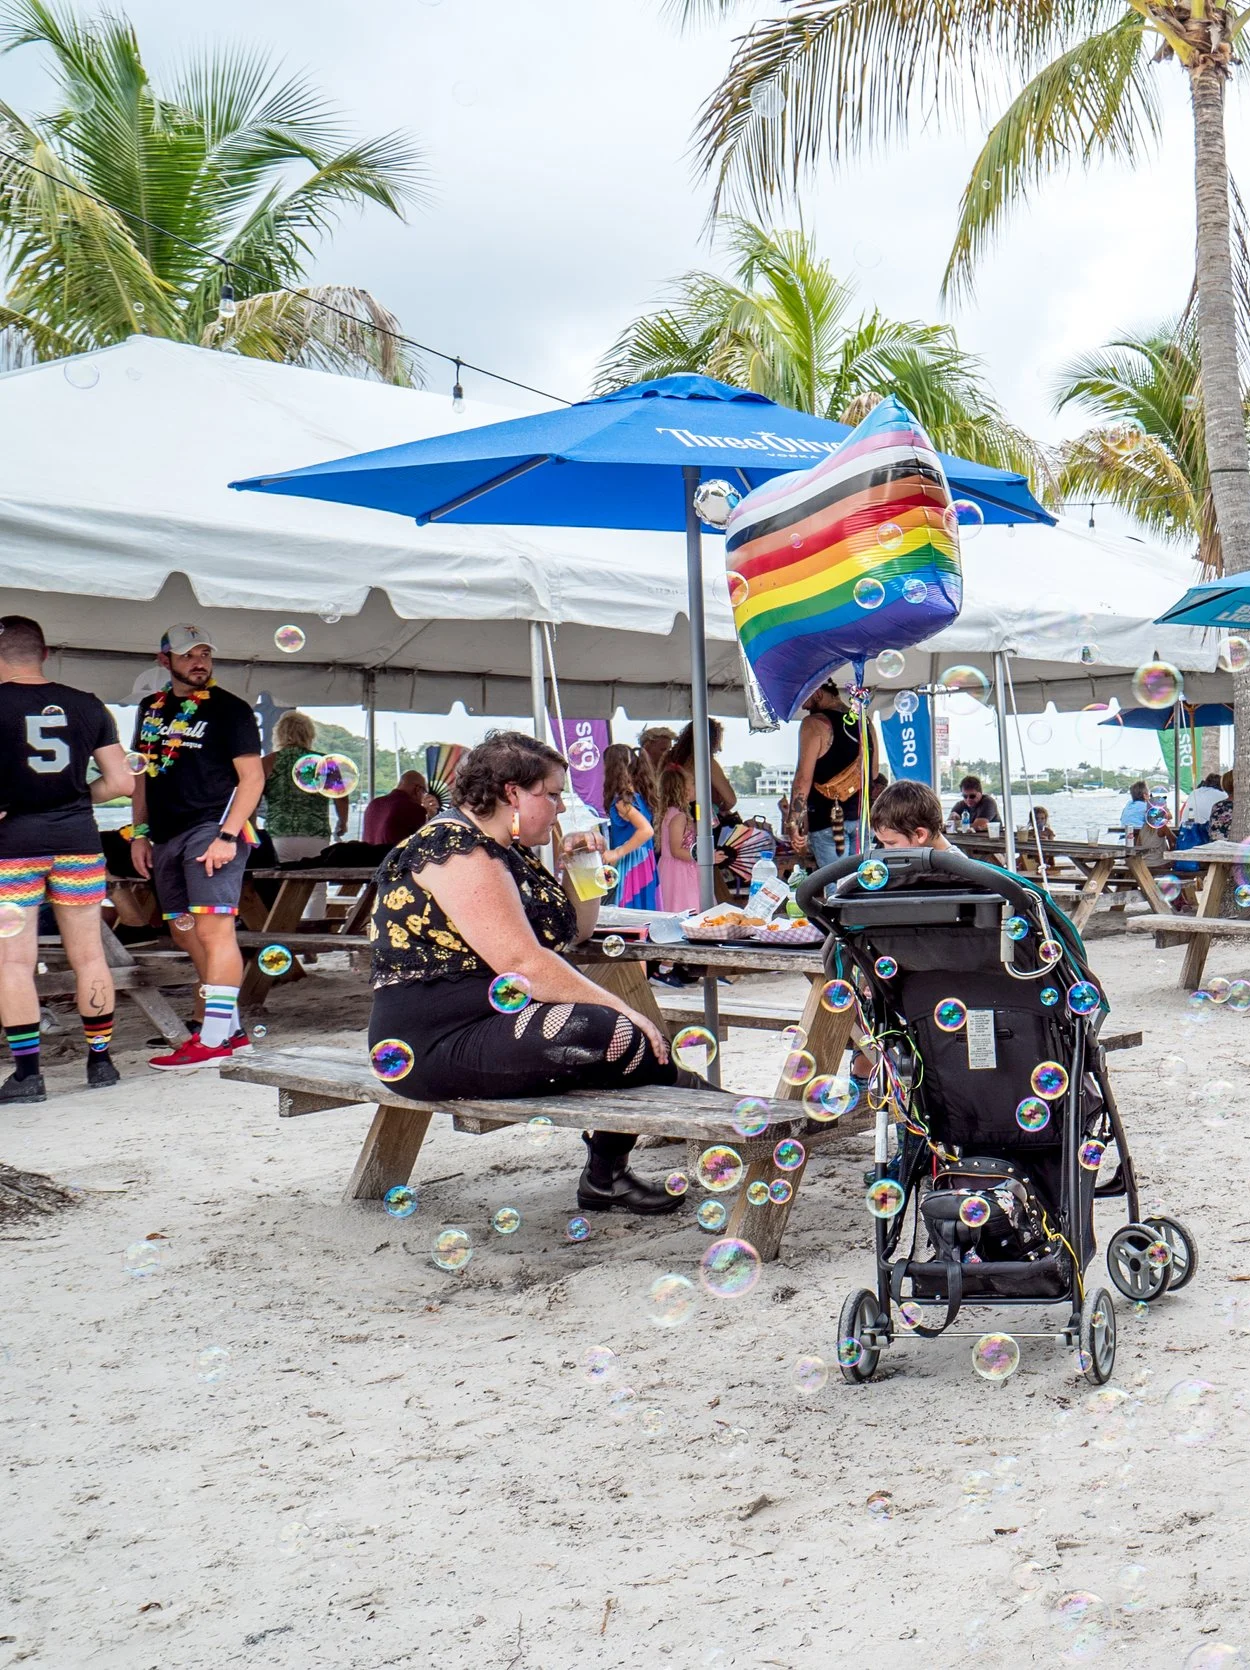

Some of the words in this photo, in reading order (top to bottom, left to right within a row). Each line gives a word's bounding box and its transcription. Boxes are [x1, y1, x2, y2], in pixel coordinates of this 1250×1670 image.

[25, 714, 71, 773] 5
[575, 721, 595, 768] SRQ
[901, 727, 918, 767] SRQ
[1179, 733, 1194, 767] SRQ
